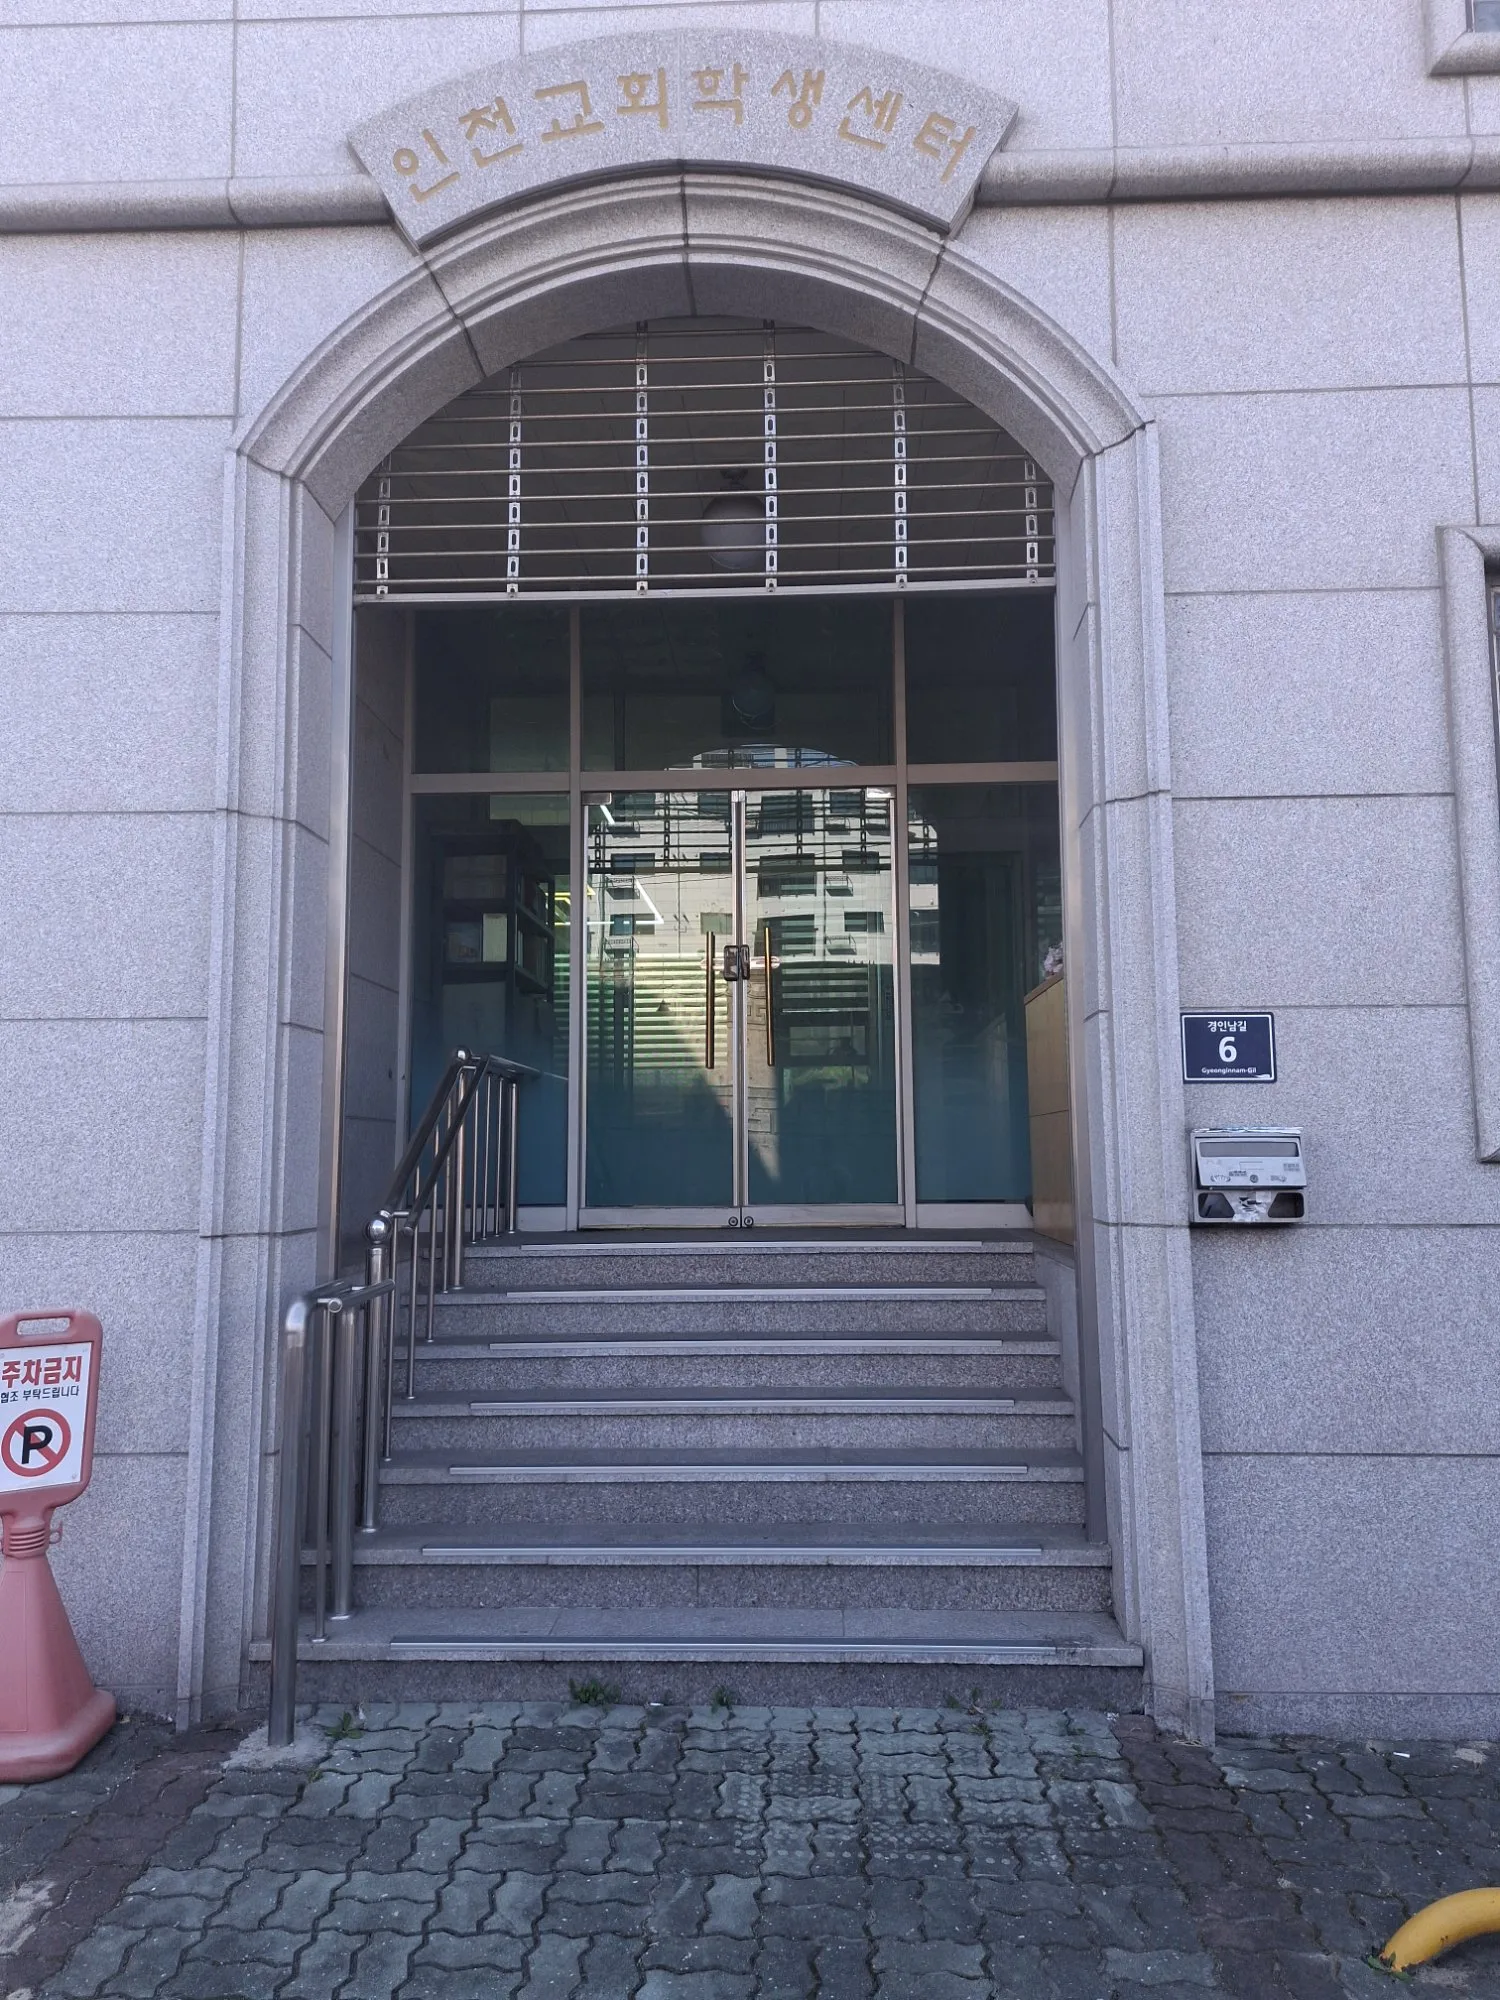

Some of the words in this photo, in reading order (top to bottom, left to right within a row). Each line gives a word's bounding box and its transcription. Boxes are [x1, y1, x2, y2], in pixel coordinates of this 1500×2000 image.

[1207, 1020, 1247, 1032] 경인남길
[1218, 1036, 1237, 1062] 6
[2, 1356, 82, 1388] 주차금지
[23, 1386, 79, 1401] 부탁드립니다
[21, 1425, 53, 1464] P
